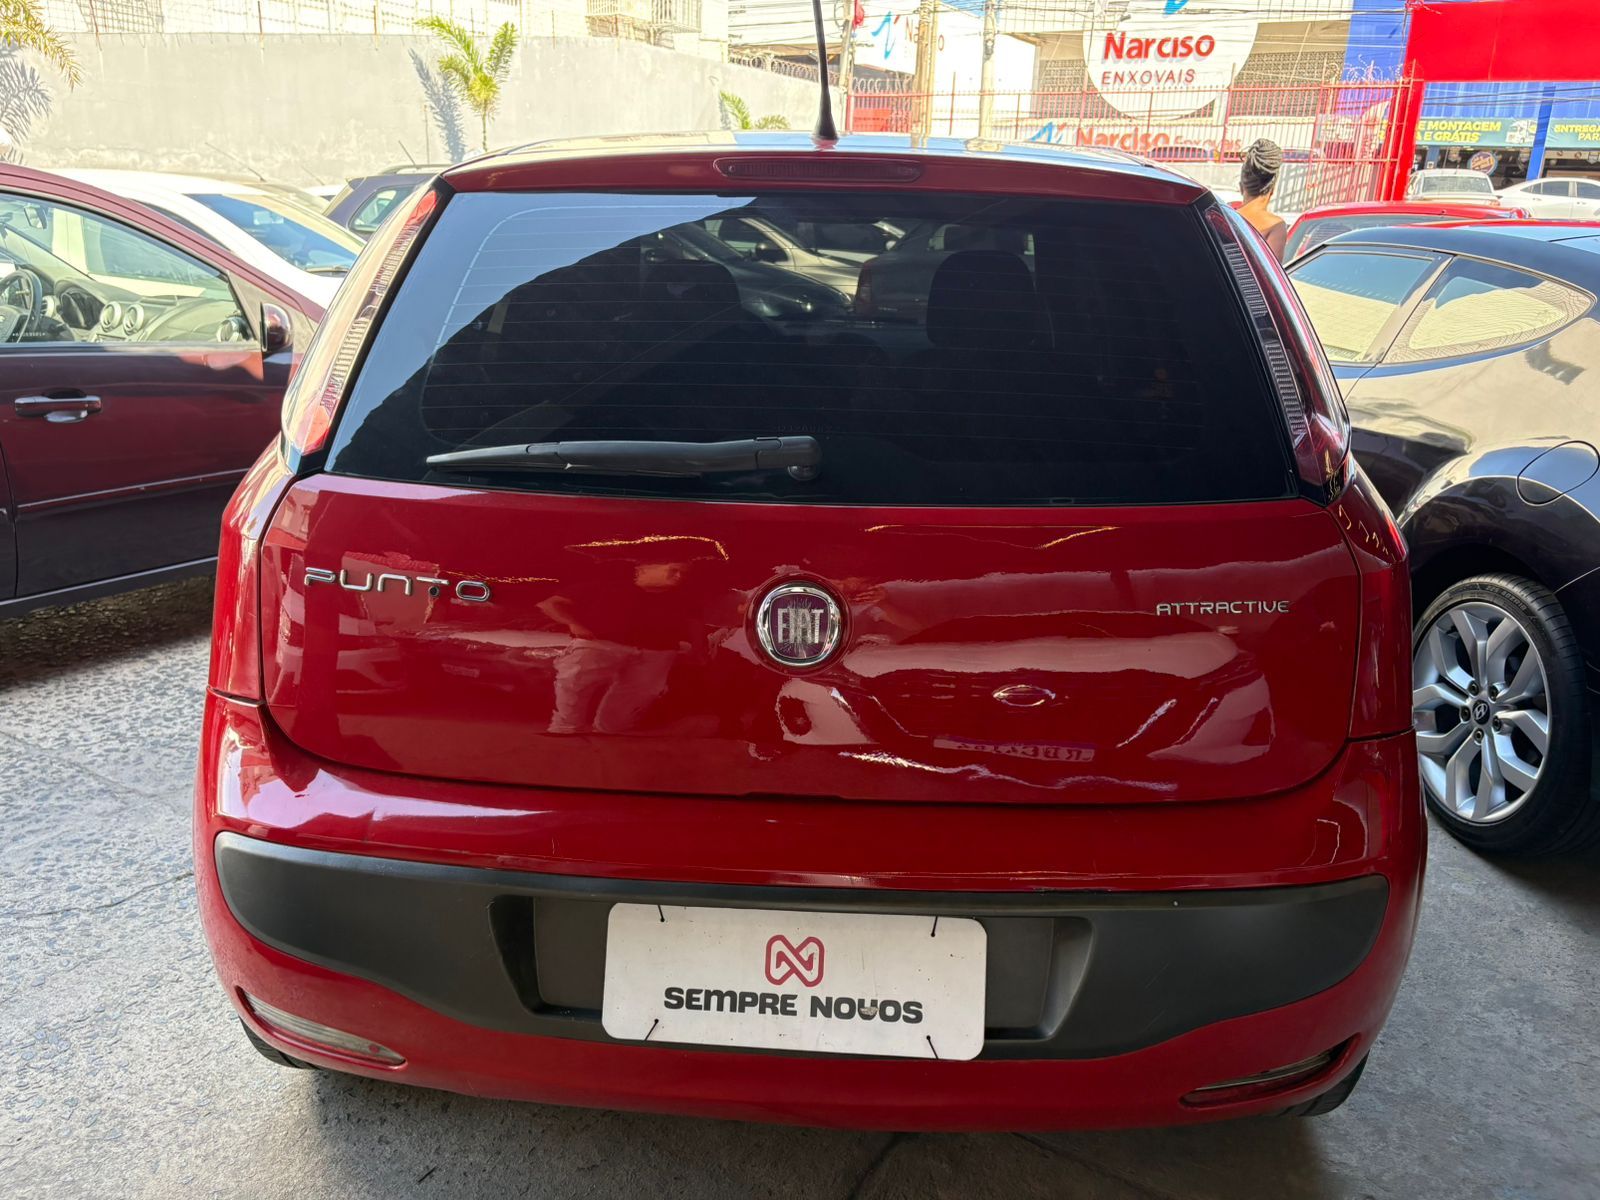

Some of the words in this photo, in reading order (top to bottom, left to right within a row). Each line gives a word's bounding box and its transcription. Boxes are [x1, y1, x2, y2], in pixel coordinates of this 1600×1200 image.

[1103, 32, 1216, 60] Narciso
[1101, 68, 1196, 86] ENXOVAIS
[1427, 120, 1502, 131] MONTAGEM
[1433, 129, 1481, 143] GRÁTIS
[1077, 126, 1170, 151] Narciso
[303, 566, 491, 602] PUNTO
[1156, 600, 1290, 616] ATTRACTIVE
[777, 608, 824, 644] FIAT
[663, 986, 799, 1017] SEMPRE
